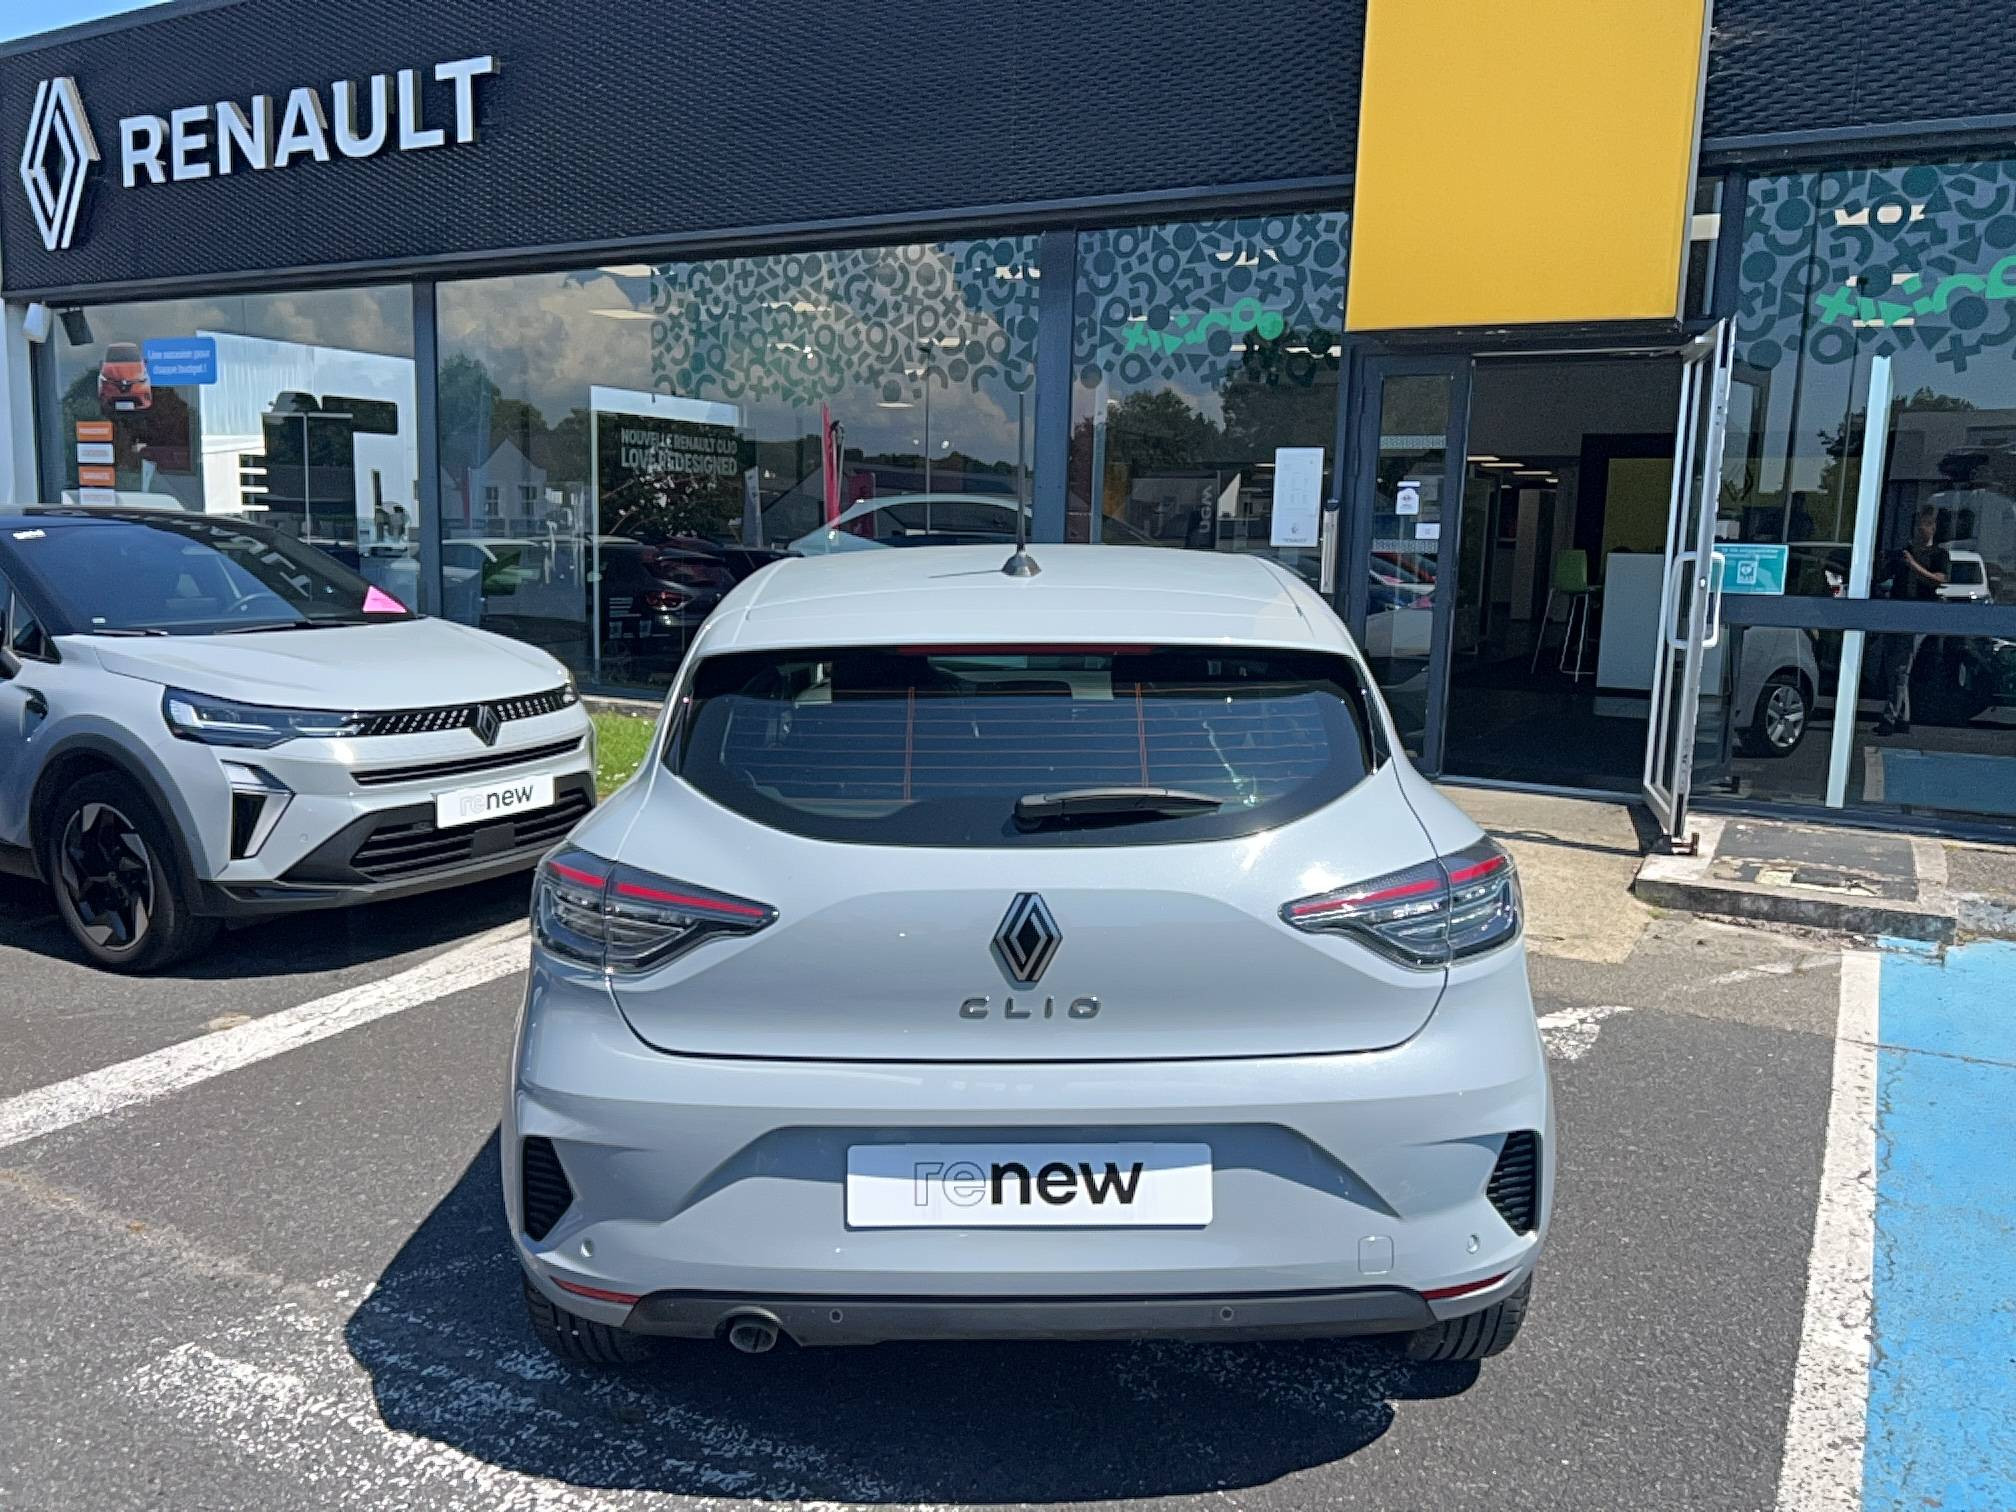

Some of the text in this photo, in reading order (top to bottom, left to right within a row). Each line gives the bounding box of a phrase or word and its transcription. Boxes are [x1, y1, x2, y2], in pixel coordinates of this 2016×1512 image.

[119, 55, 496, 188] RENAULT
[621, 428, 672, 448] NOUVELLE
[674, 433, 715, 453] RENAULT
[621, 447, 738, 476] LOVE REDESIGNED
[959, 996, 1102, 1019] CLIO
[913, 1161, 1144, 1208] renew
